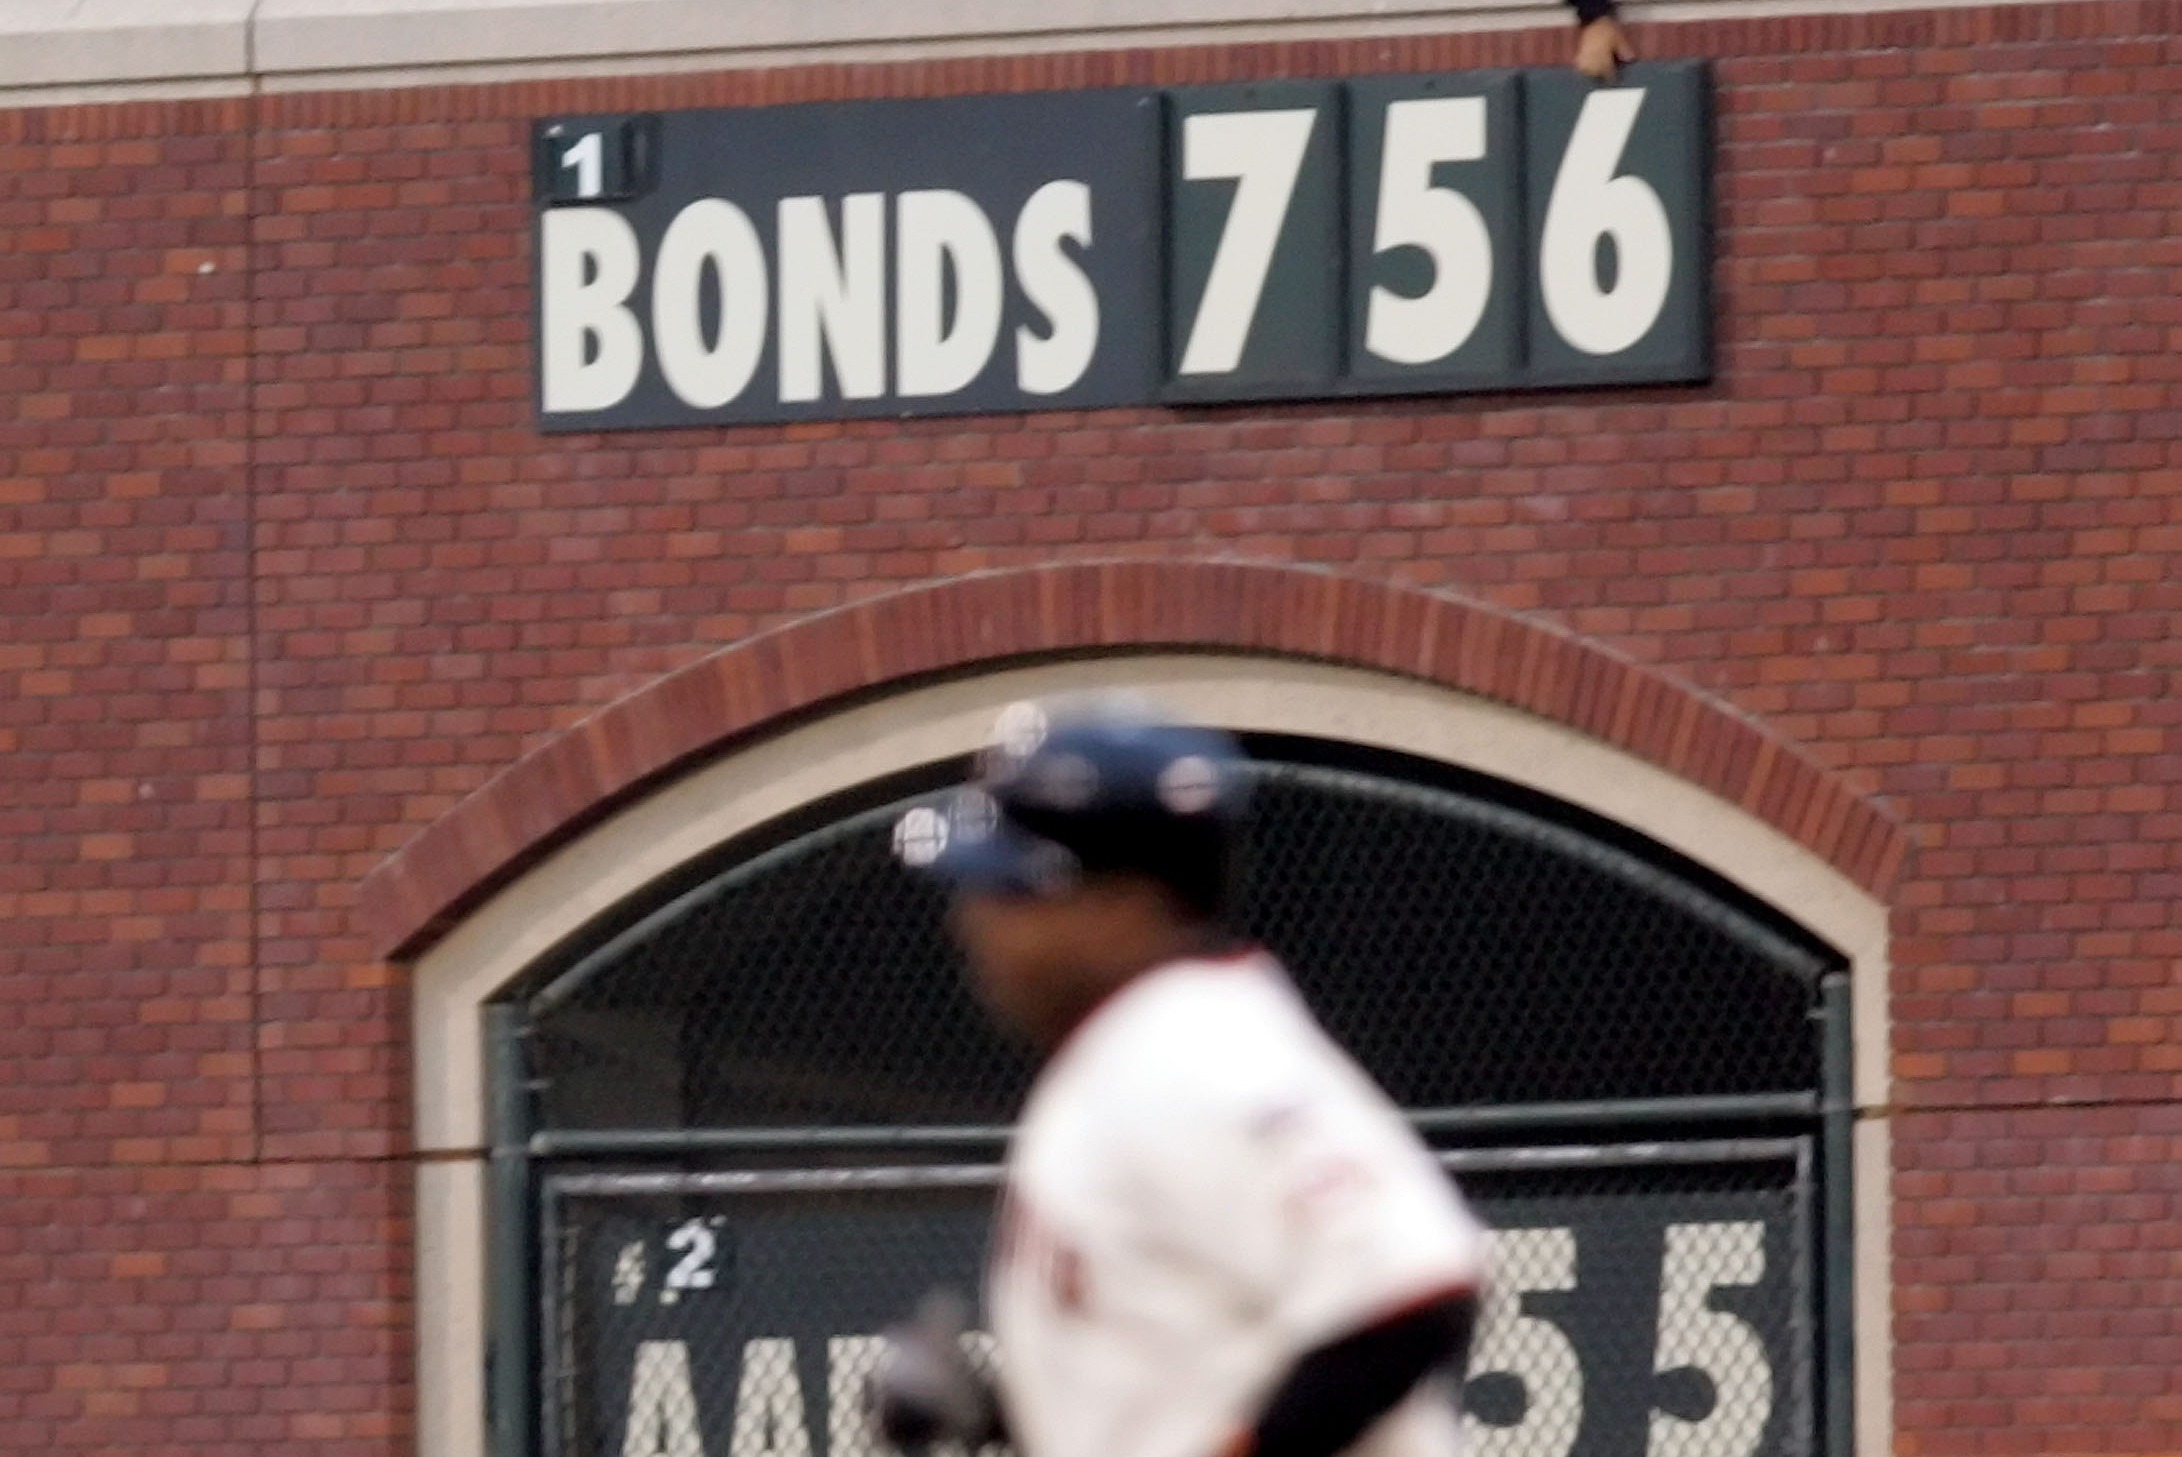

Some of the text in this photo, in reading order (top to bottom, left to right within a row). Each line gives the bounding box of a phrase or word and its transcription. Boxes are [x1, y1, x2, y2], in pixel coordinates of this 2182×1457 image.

[541, 87, 1674, 413] BONDS 756
[561, 132, 604, 197] 1
